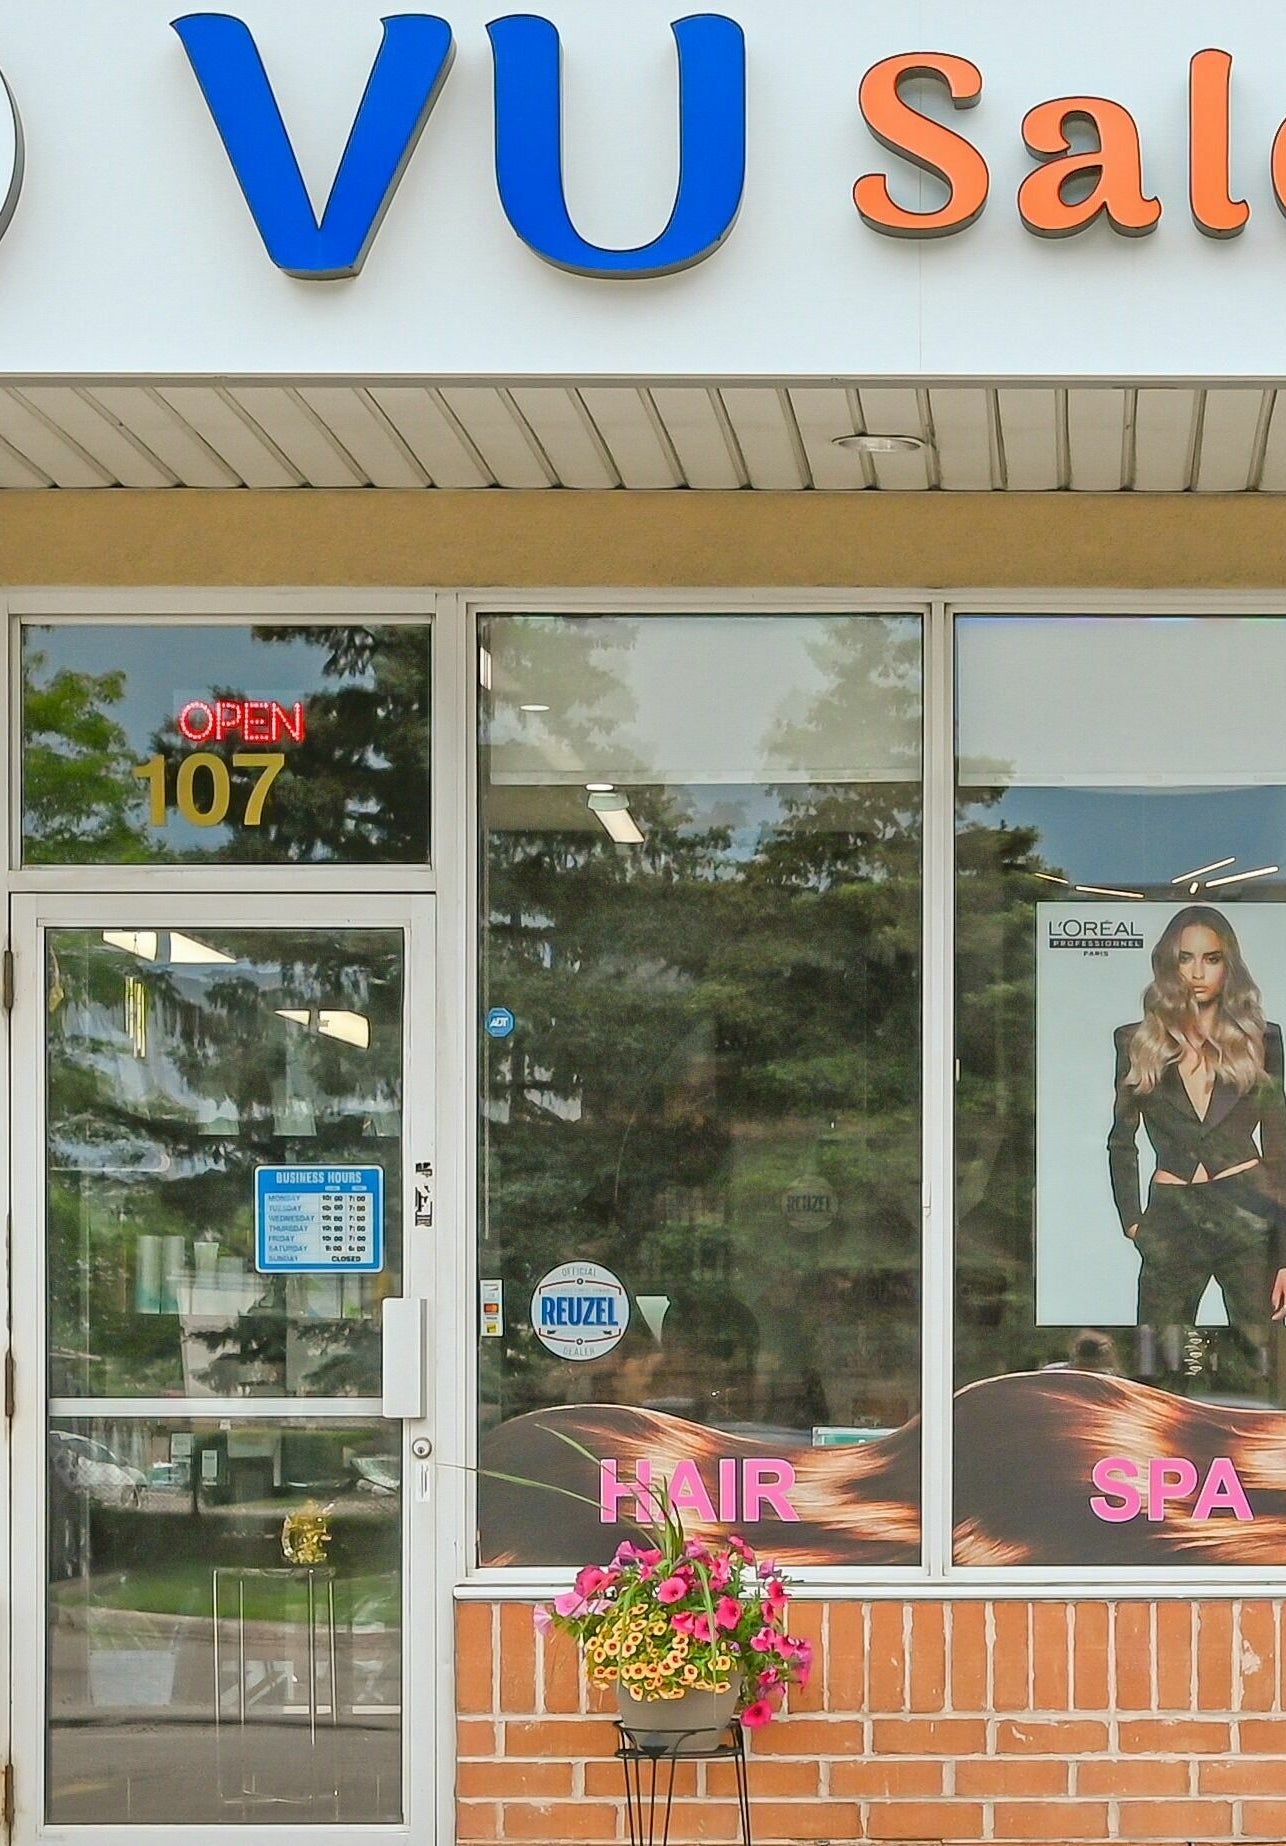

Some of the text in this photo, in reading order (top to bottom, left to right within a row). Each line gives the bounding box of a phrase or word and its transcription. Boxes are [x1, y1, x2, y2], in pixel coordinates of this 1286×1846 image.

[170, 12, 746, 280] VU
[178, 700, 306, 743] OPEN
[133, 752, 286, 827] 107
[1052, 940, 1141, 948] PROFESSIONNEL
[489, 1016, 509, 1027] ADT
[276, 1171, 362, 1184] BUSINESS HOURS
[541, 1296, 619, 1326] REUZEL
[599, 1457, 801, 1523] HAIR
[1089, 1456, 1255, 1523] SPA
